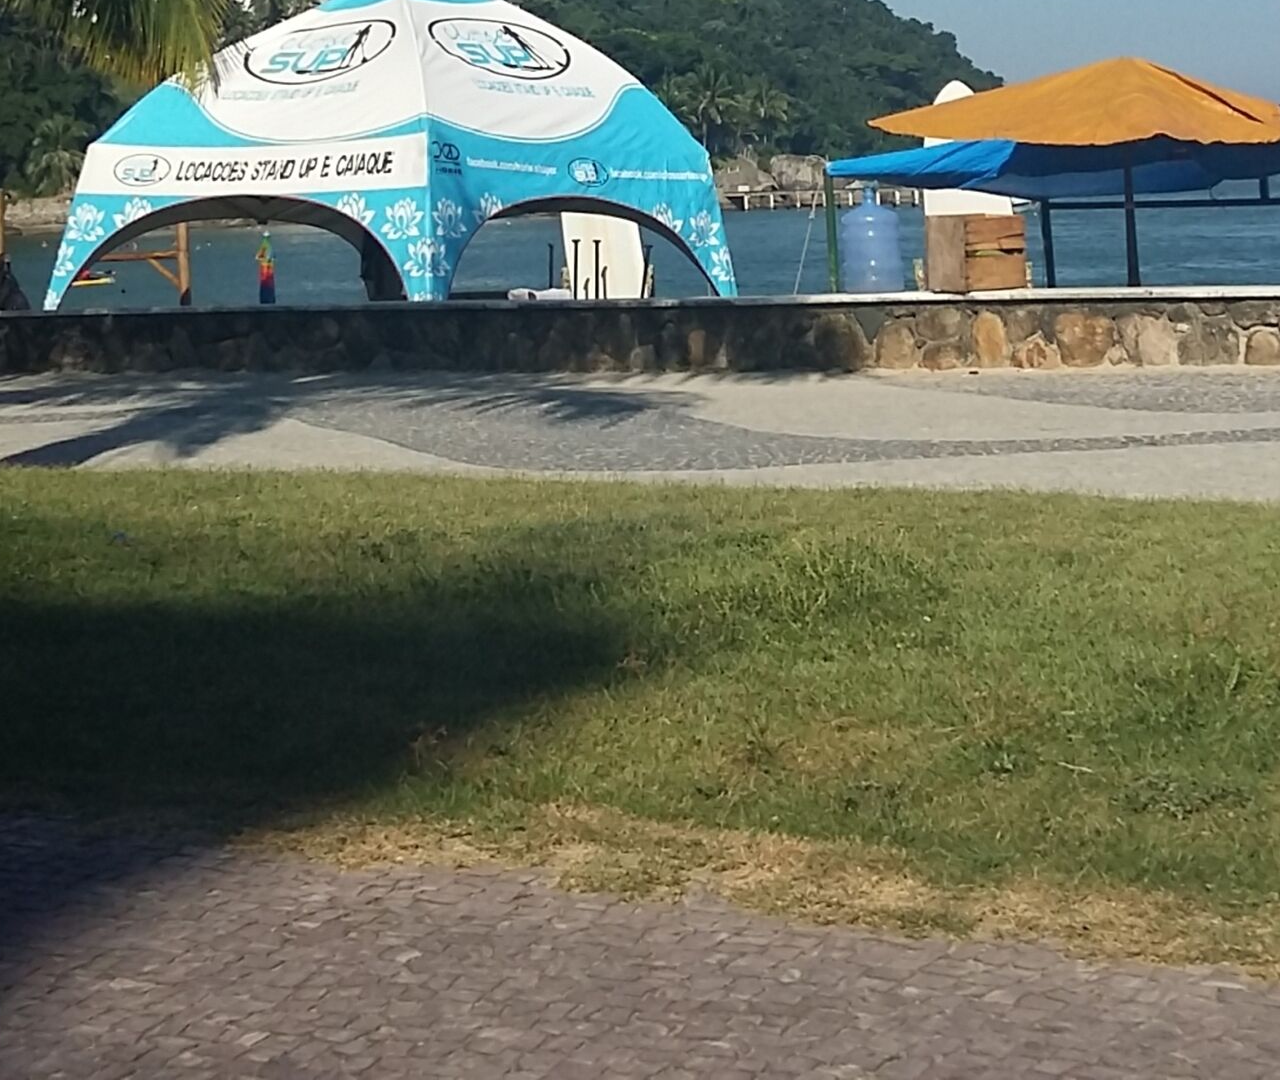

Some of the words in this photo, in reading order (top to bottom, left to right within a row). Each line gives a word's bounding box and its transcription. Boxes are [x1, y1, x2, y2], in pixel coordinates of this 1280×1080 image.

[259, 47, 348, 74] SUP
[456, 42, 533, 69] SUP
[250, 159, 296, 181] STAND
[298, 157, 319, 180] UP
[320, 155, 334, 178] E
[335, 151, 393, 177] CAIAQUE
